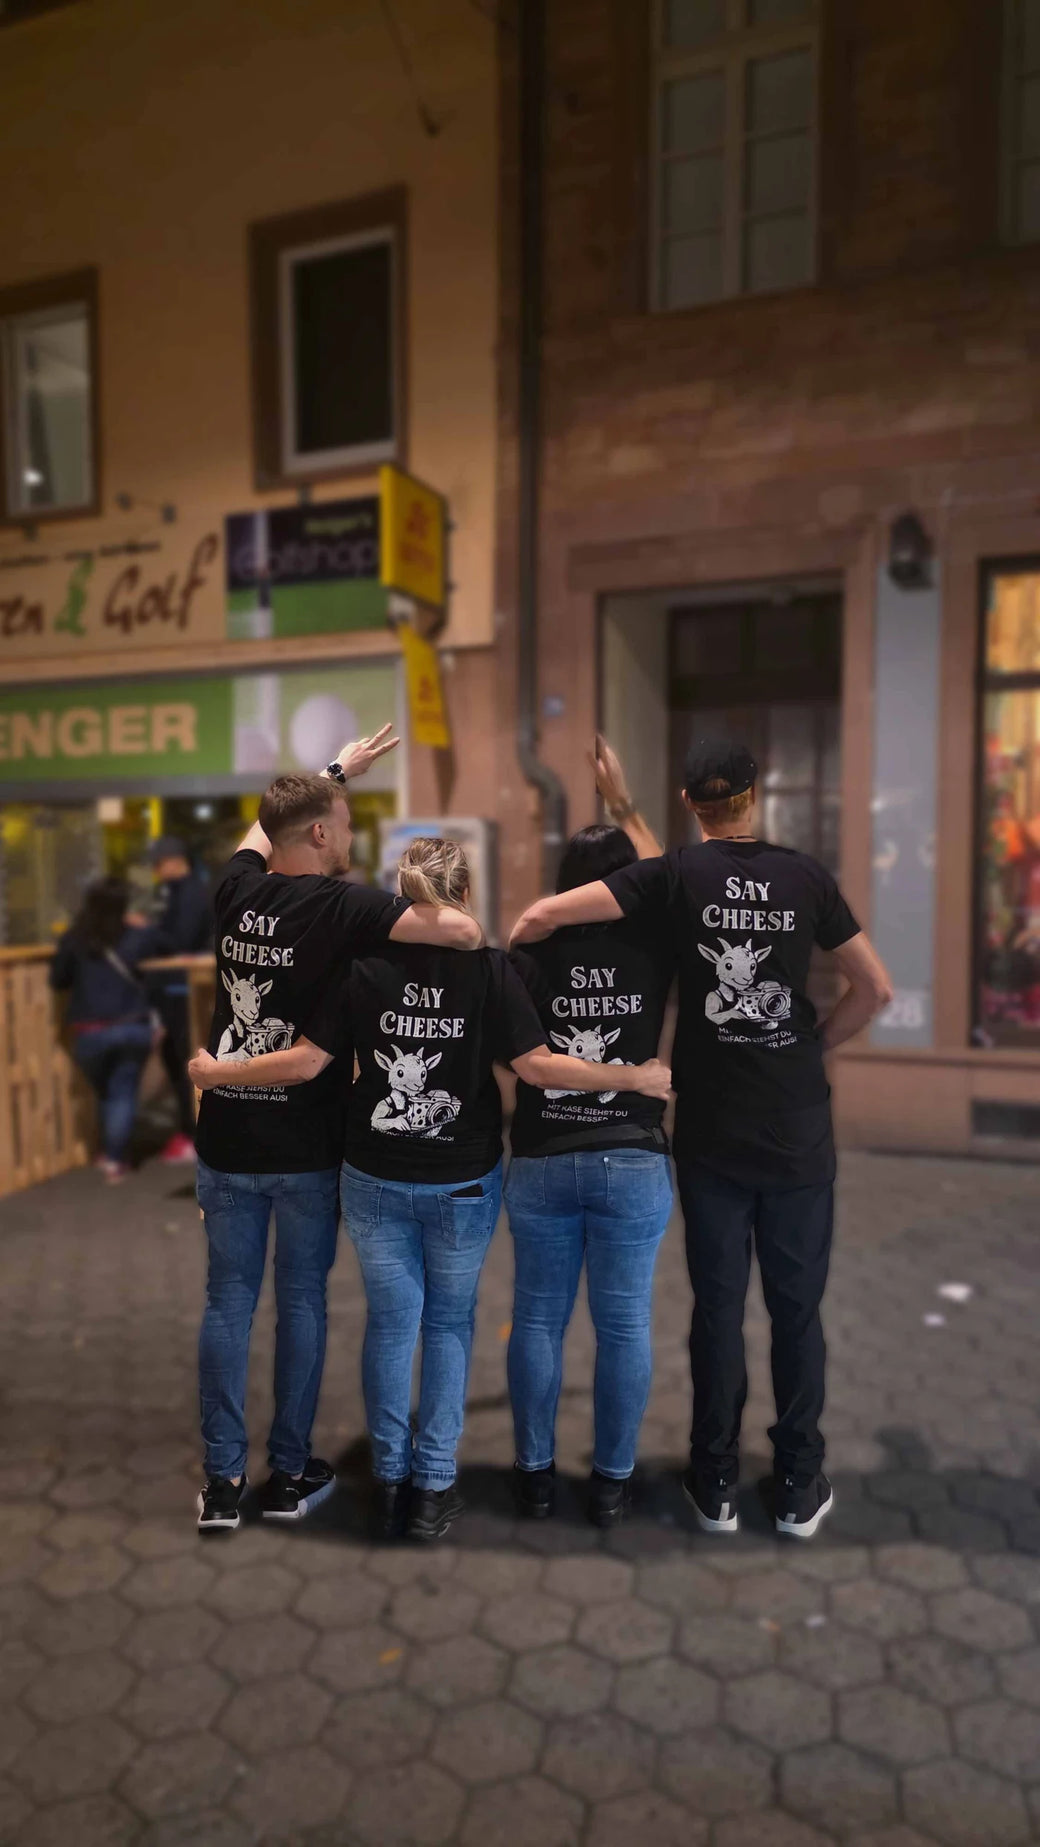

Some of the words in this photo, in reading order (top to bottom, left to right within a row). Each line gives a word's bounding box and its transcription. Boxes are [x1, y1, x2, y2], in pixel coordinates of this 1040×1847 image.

[725, 876, 771, 901] SAY
[238, 910, 280, 937] SAY
[702, 904, 795, 931] CHEESE
[221, 935, 294, 967] CHEESE
[570, 966, 616, 989] SAY
[402, 982, 445, 1009] SAY
[551, 995, 643, 1018] CHEESE
[379, 1010, 465, 1038] CHEESE
[239, 1092, 268, 1100] BESSER
[541, 1110, 576, 1121] EINFACH
